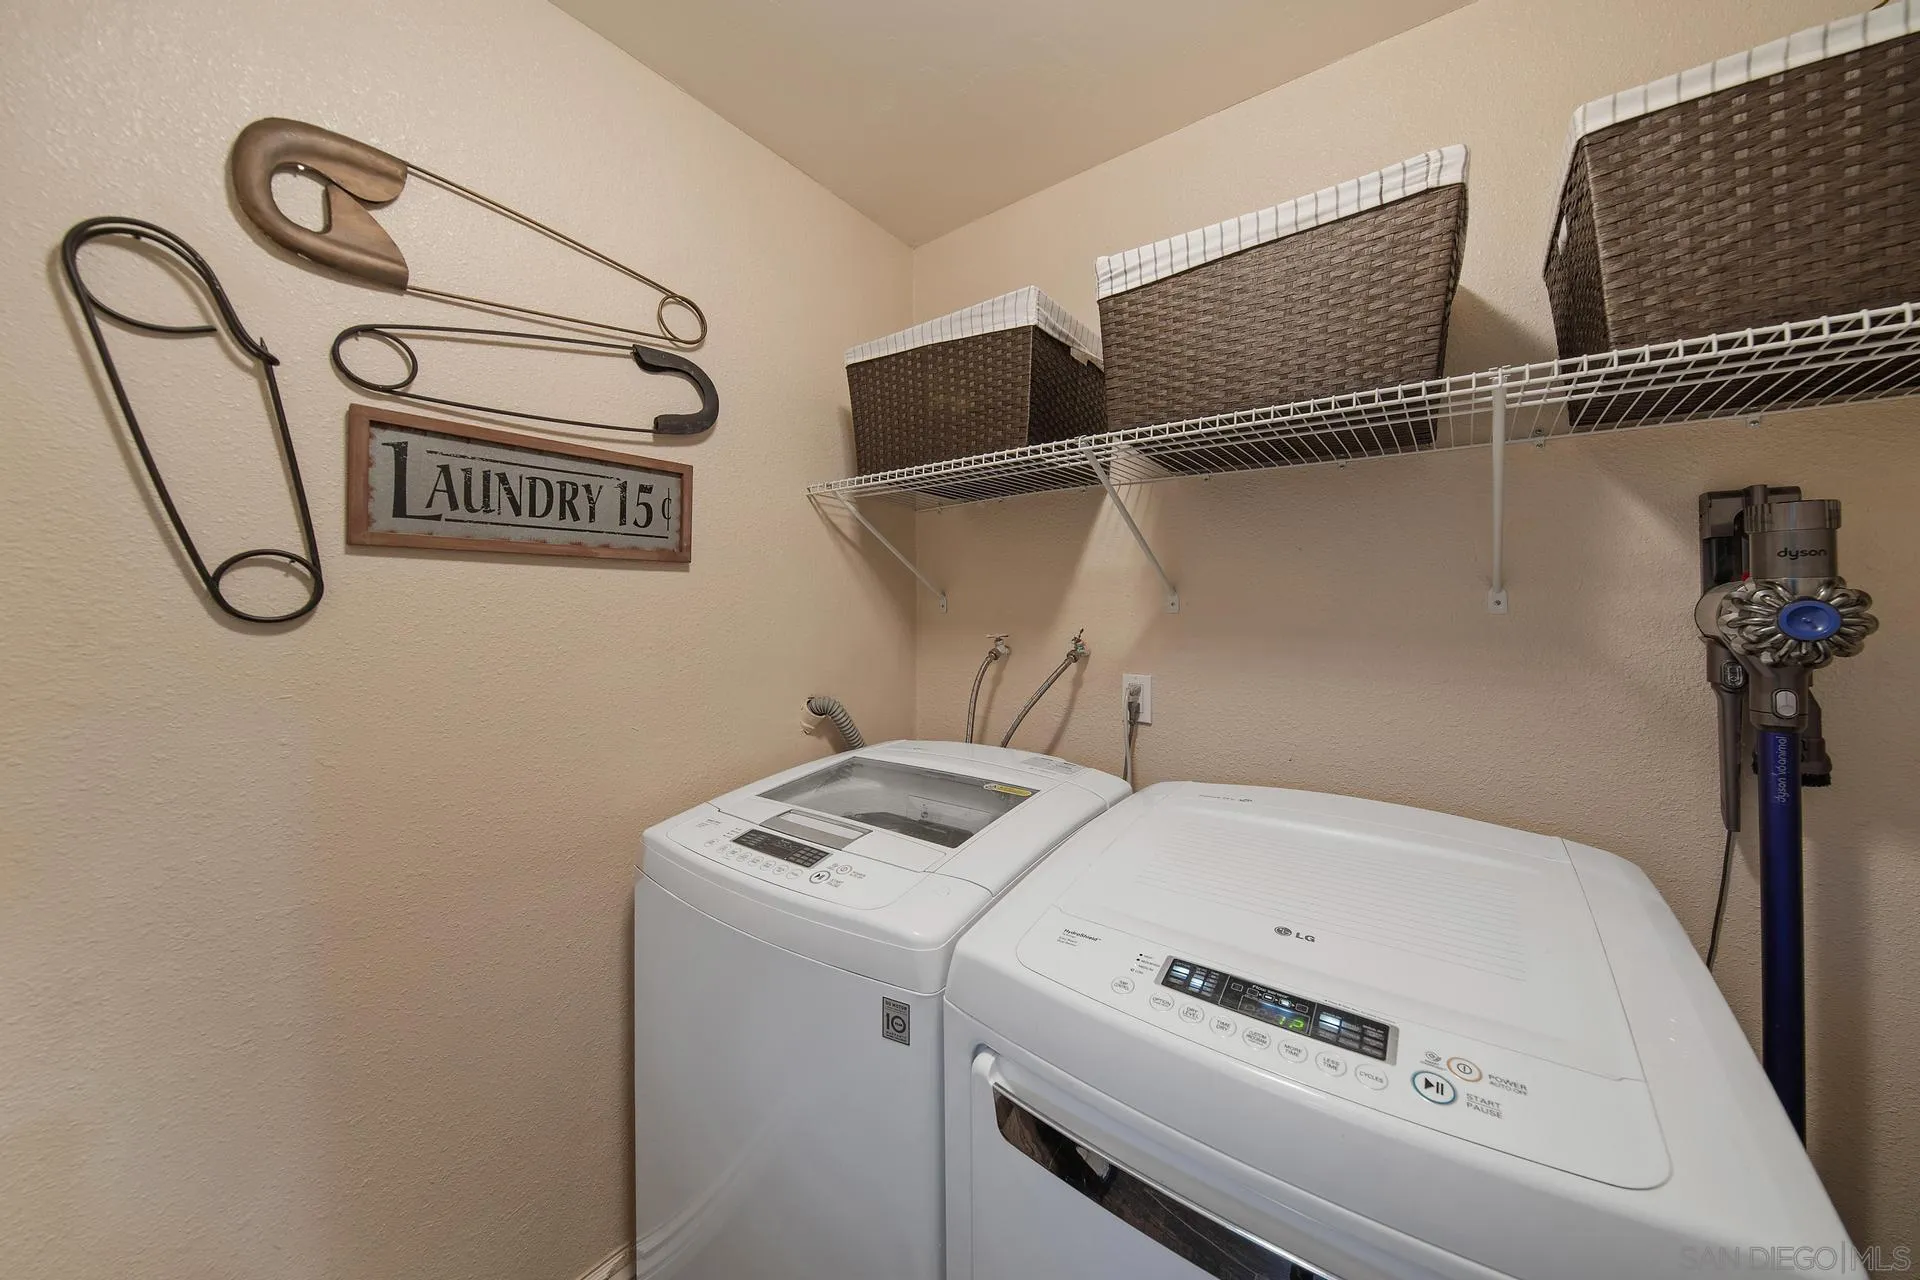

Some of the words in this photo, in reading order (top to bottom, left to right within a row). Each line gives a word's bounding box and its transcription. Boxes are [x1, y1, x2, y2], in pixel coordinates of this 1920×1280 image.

[382, 441, 603, 524] LAUNDRY
[1777, 547, 1828, 560] dyson
[1775, 778, 1790, 803] dyson
[1295, 932, 1315, 943] LG
[1152, 996, 1172, 1007] OPTION
[1182, 1010, 1200, 1020] LEVEL
[1186, 1006, 1198, 1014] DRY
[1284, 1044, 1302, 1053] MORE
[1285, 1049, 1300, 1058] TIME
[1323, 1056, 1340, 1066] LESS
[1323, 1061, 1338, 1072] TIME
[1359, 1070, 1384, 1084] CYCLES
[1488, 1073, 1528, 1091] POWER
[1489, 1080, 1512, 1092] AUTO
[1466, 1093, 1501, 1109] START
[1466, 1102, 1503, 1119] PAUSE
